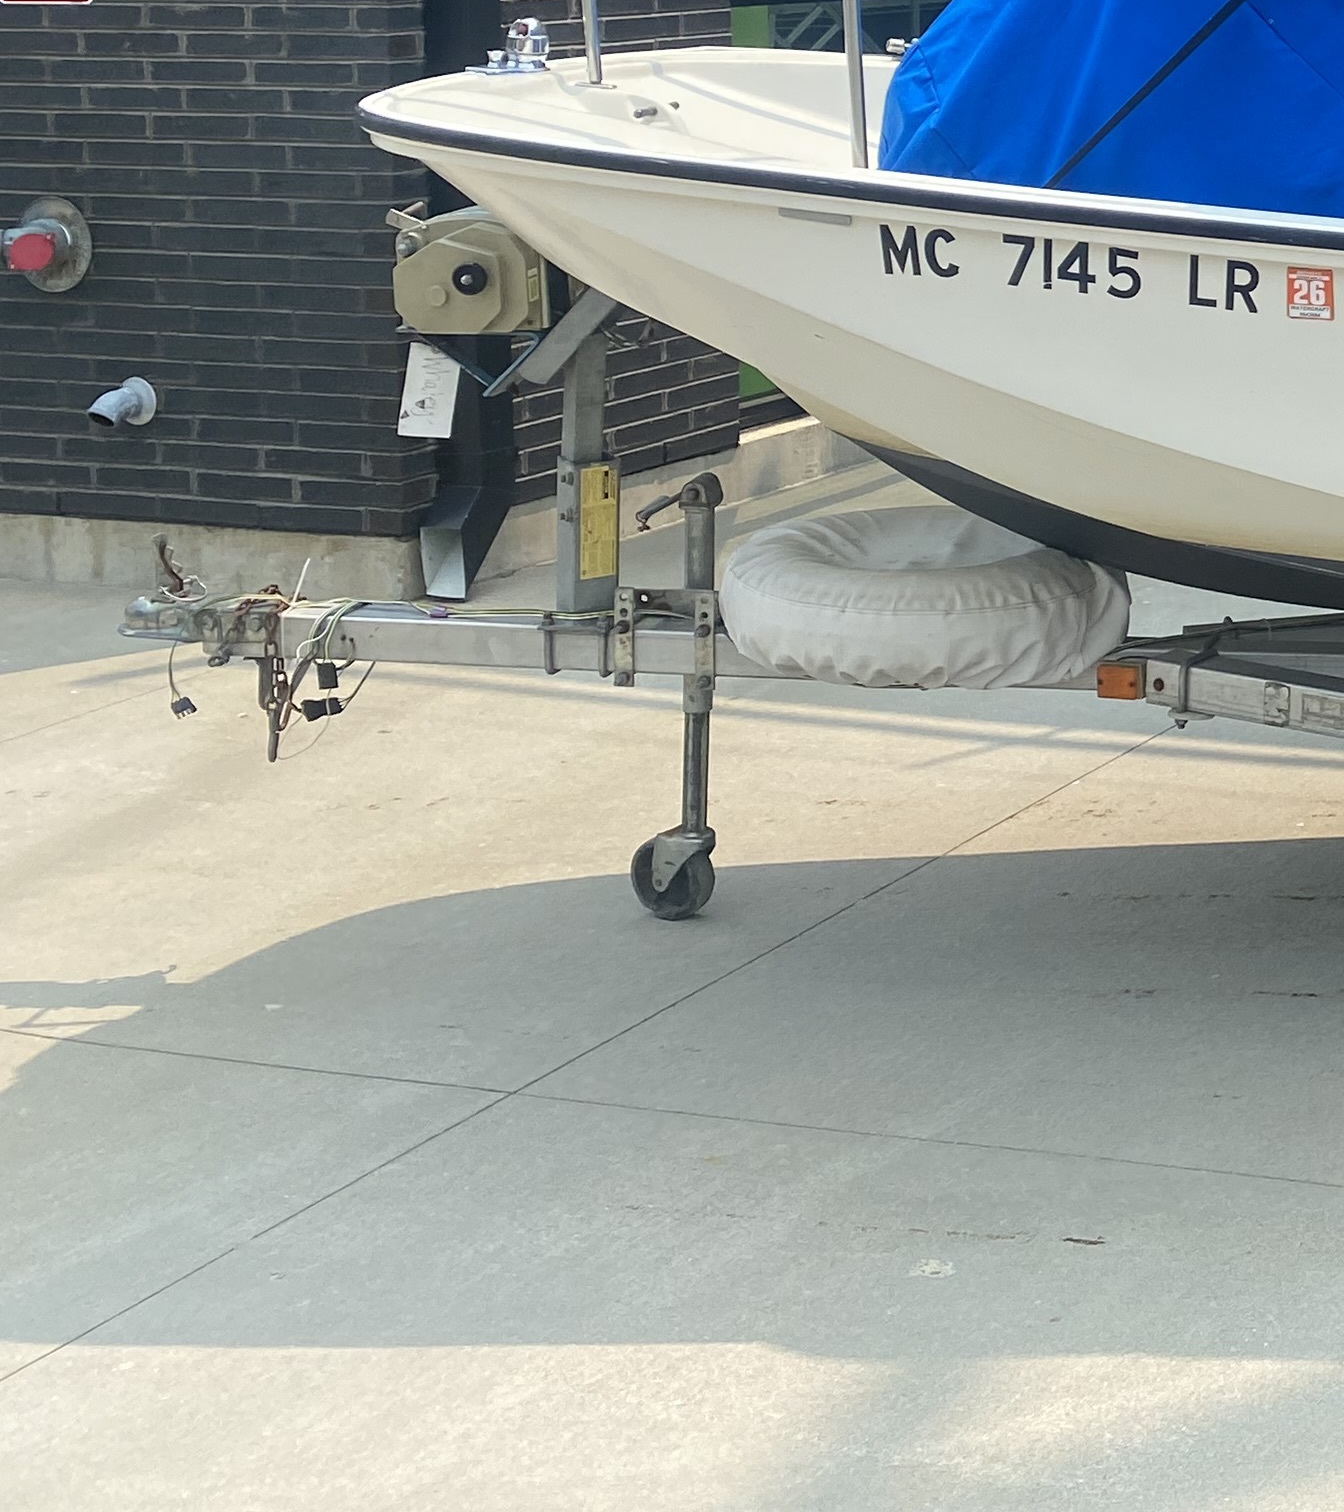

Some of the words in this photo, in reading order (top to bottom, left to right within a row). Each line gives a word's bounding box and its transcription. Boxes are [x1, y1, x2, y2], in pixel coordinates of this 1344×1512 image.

[879, 224, 960, 278] MC
[1002, 233, 1142, 300] 7145
[1189, 254, 1260, 314] LR
[1293, 279, 1326, 306] 26
